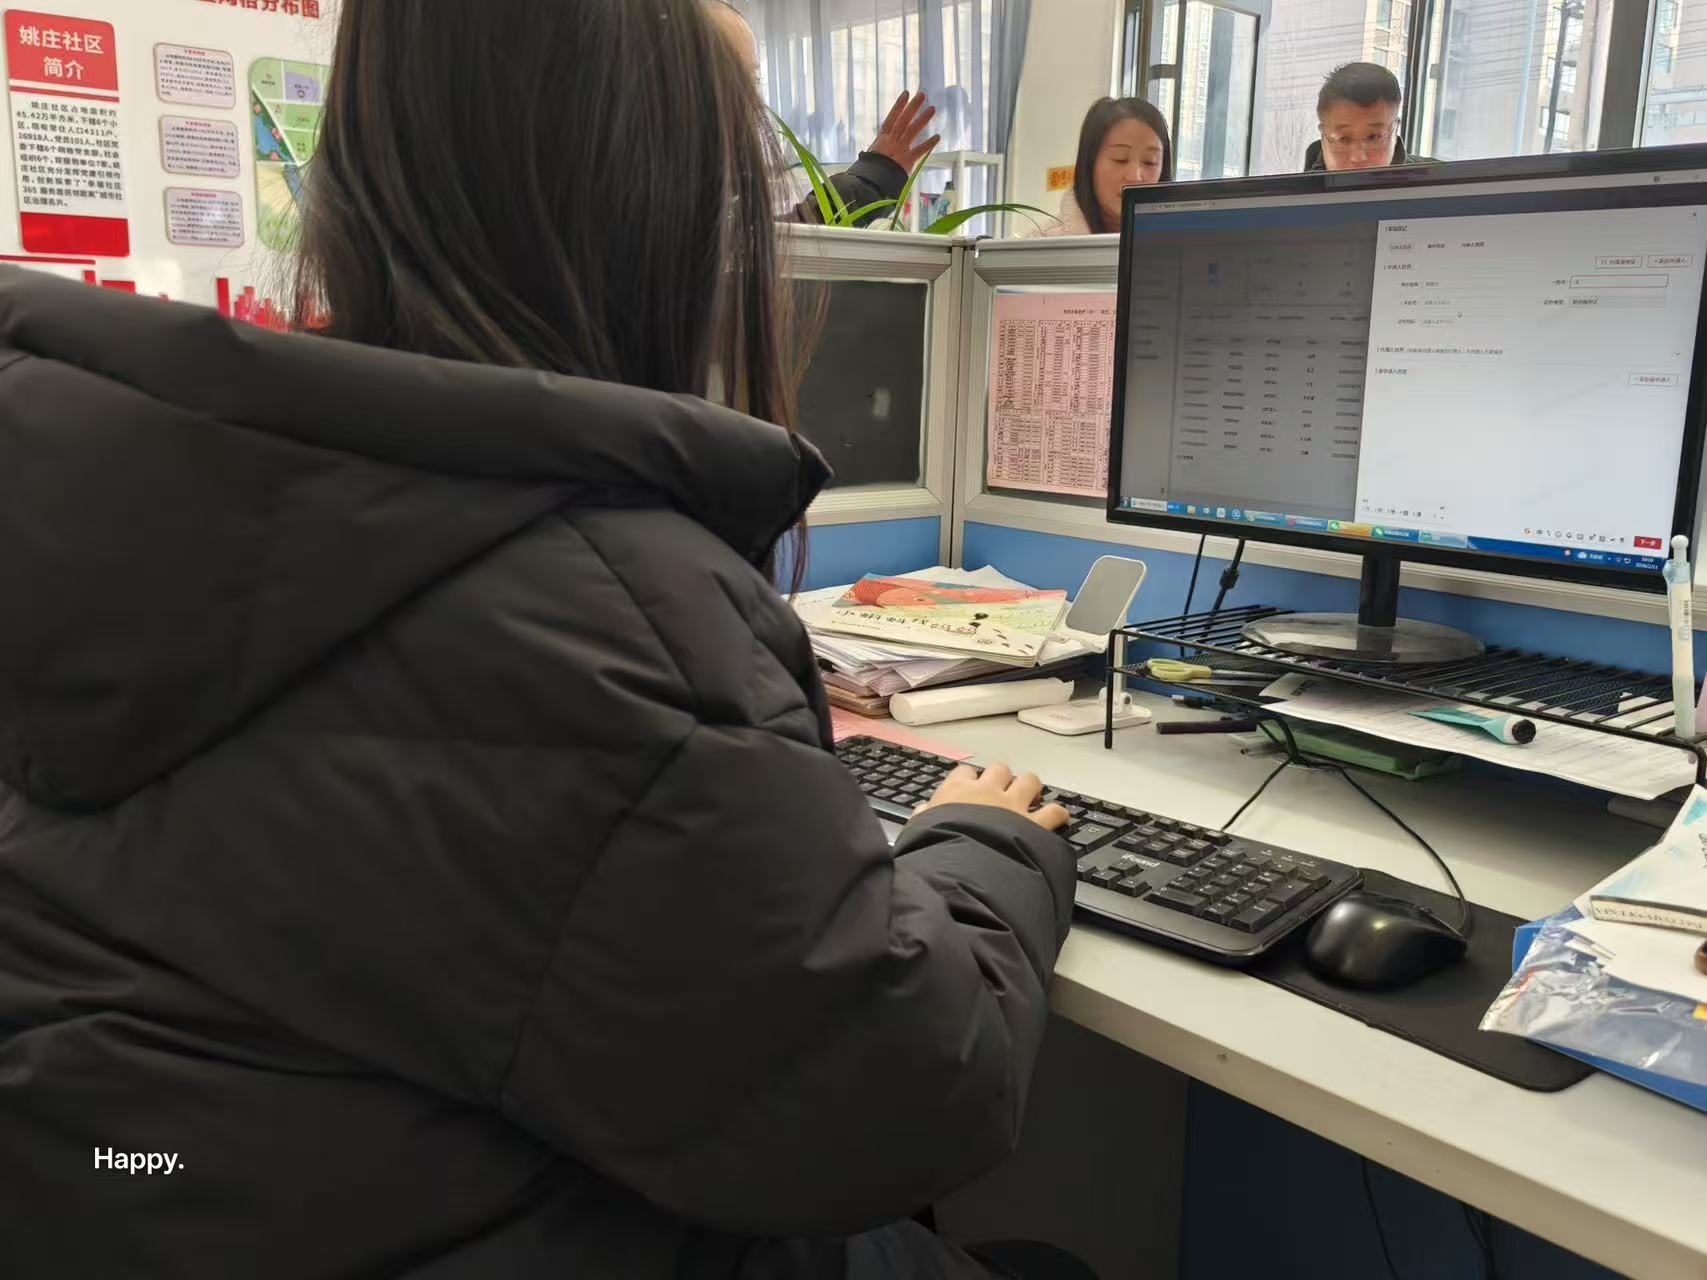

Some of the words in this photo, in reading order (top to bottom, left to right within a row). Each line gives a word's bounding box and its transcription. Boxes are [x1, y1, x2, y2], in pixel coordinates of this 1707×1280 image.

[19, 25, 104, 54] 姚庄社区
[43, 57, 84, 80] 简介
